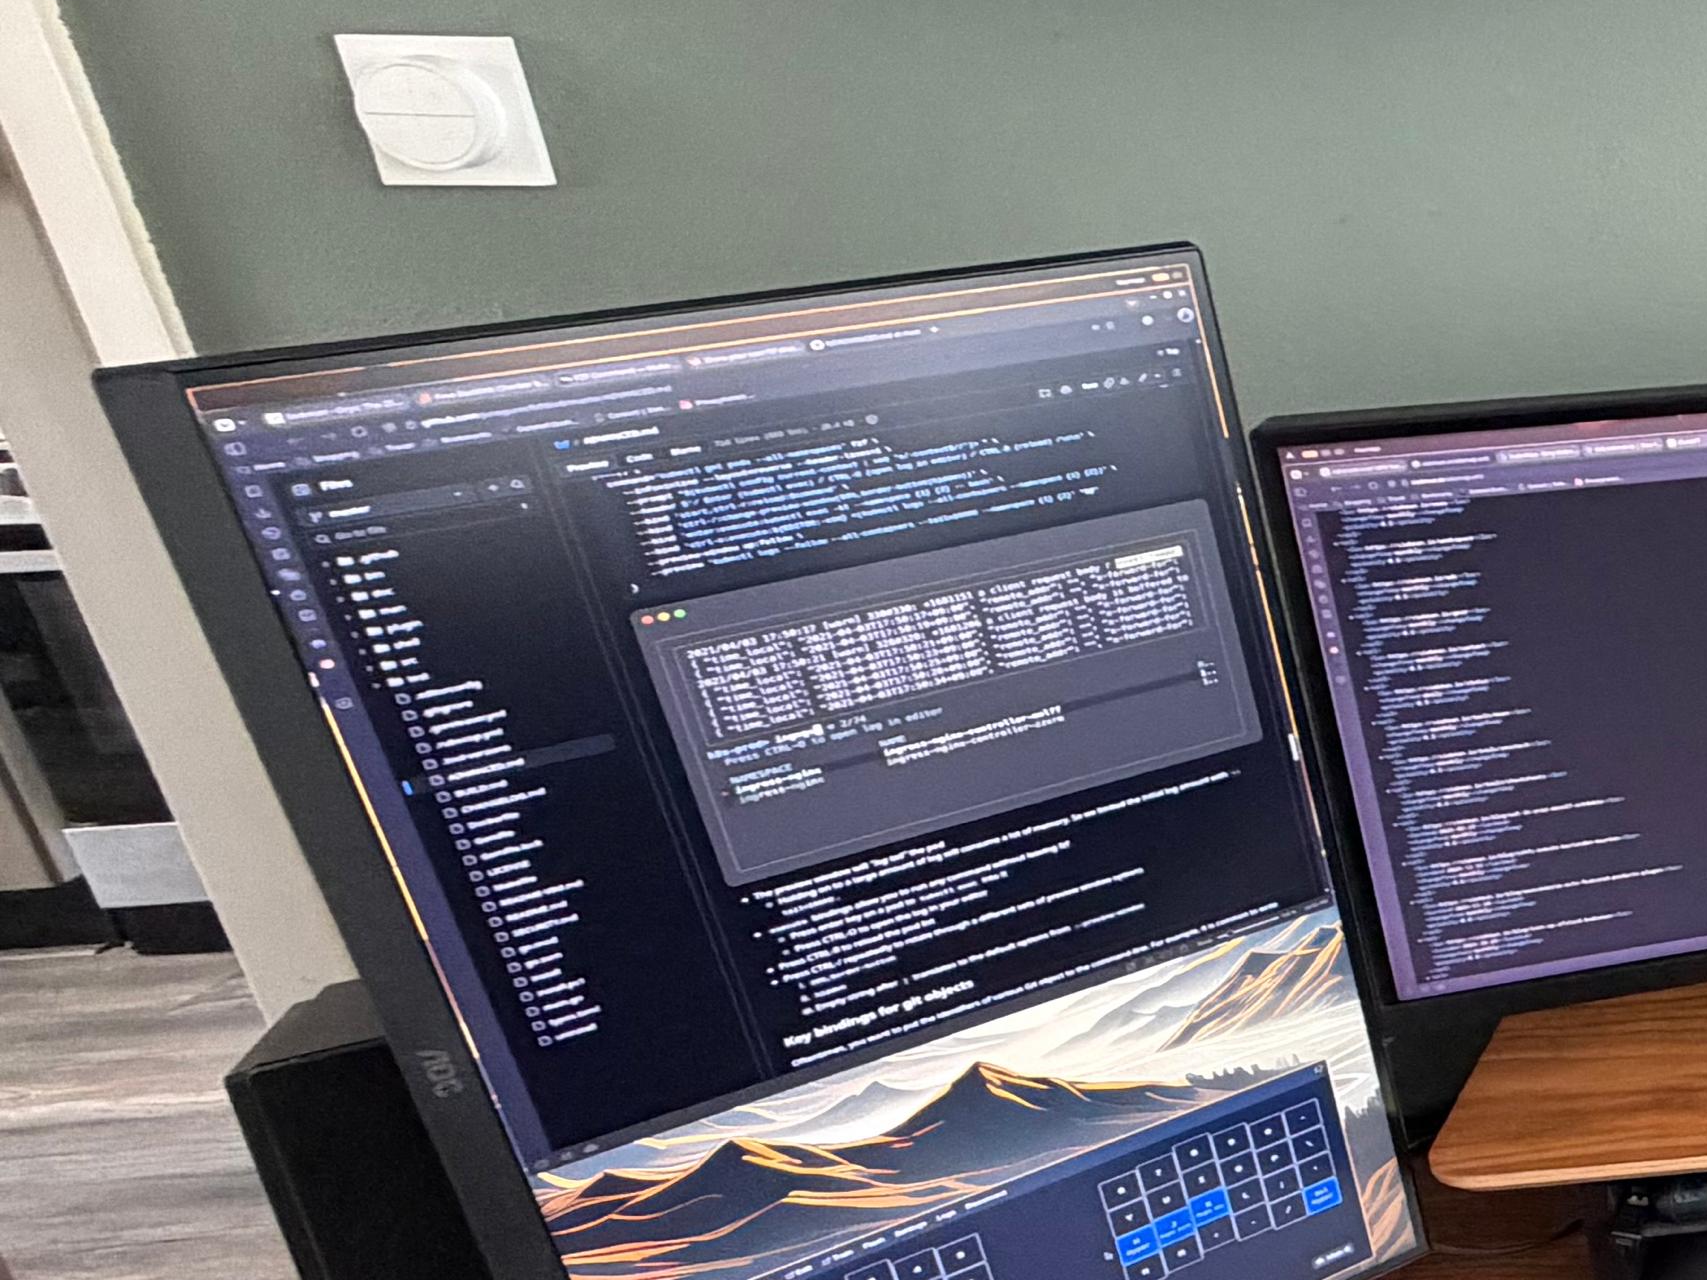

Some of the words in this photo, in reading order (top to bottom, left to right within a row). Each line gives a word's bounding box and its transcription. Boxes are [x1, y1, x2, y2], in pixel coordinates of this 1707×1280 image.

[782, 1029, 813, 1051] Key
[812, 1007, 877, 1041] bindings
[877, 999, 901, 1019] for
[900, 992, 923, 1010] git
[922, 974, 974, 1003] objects
